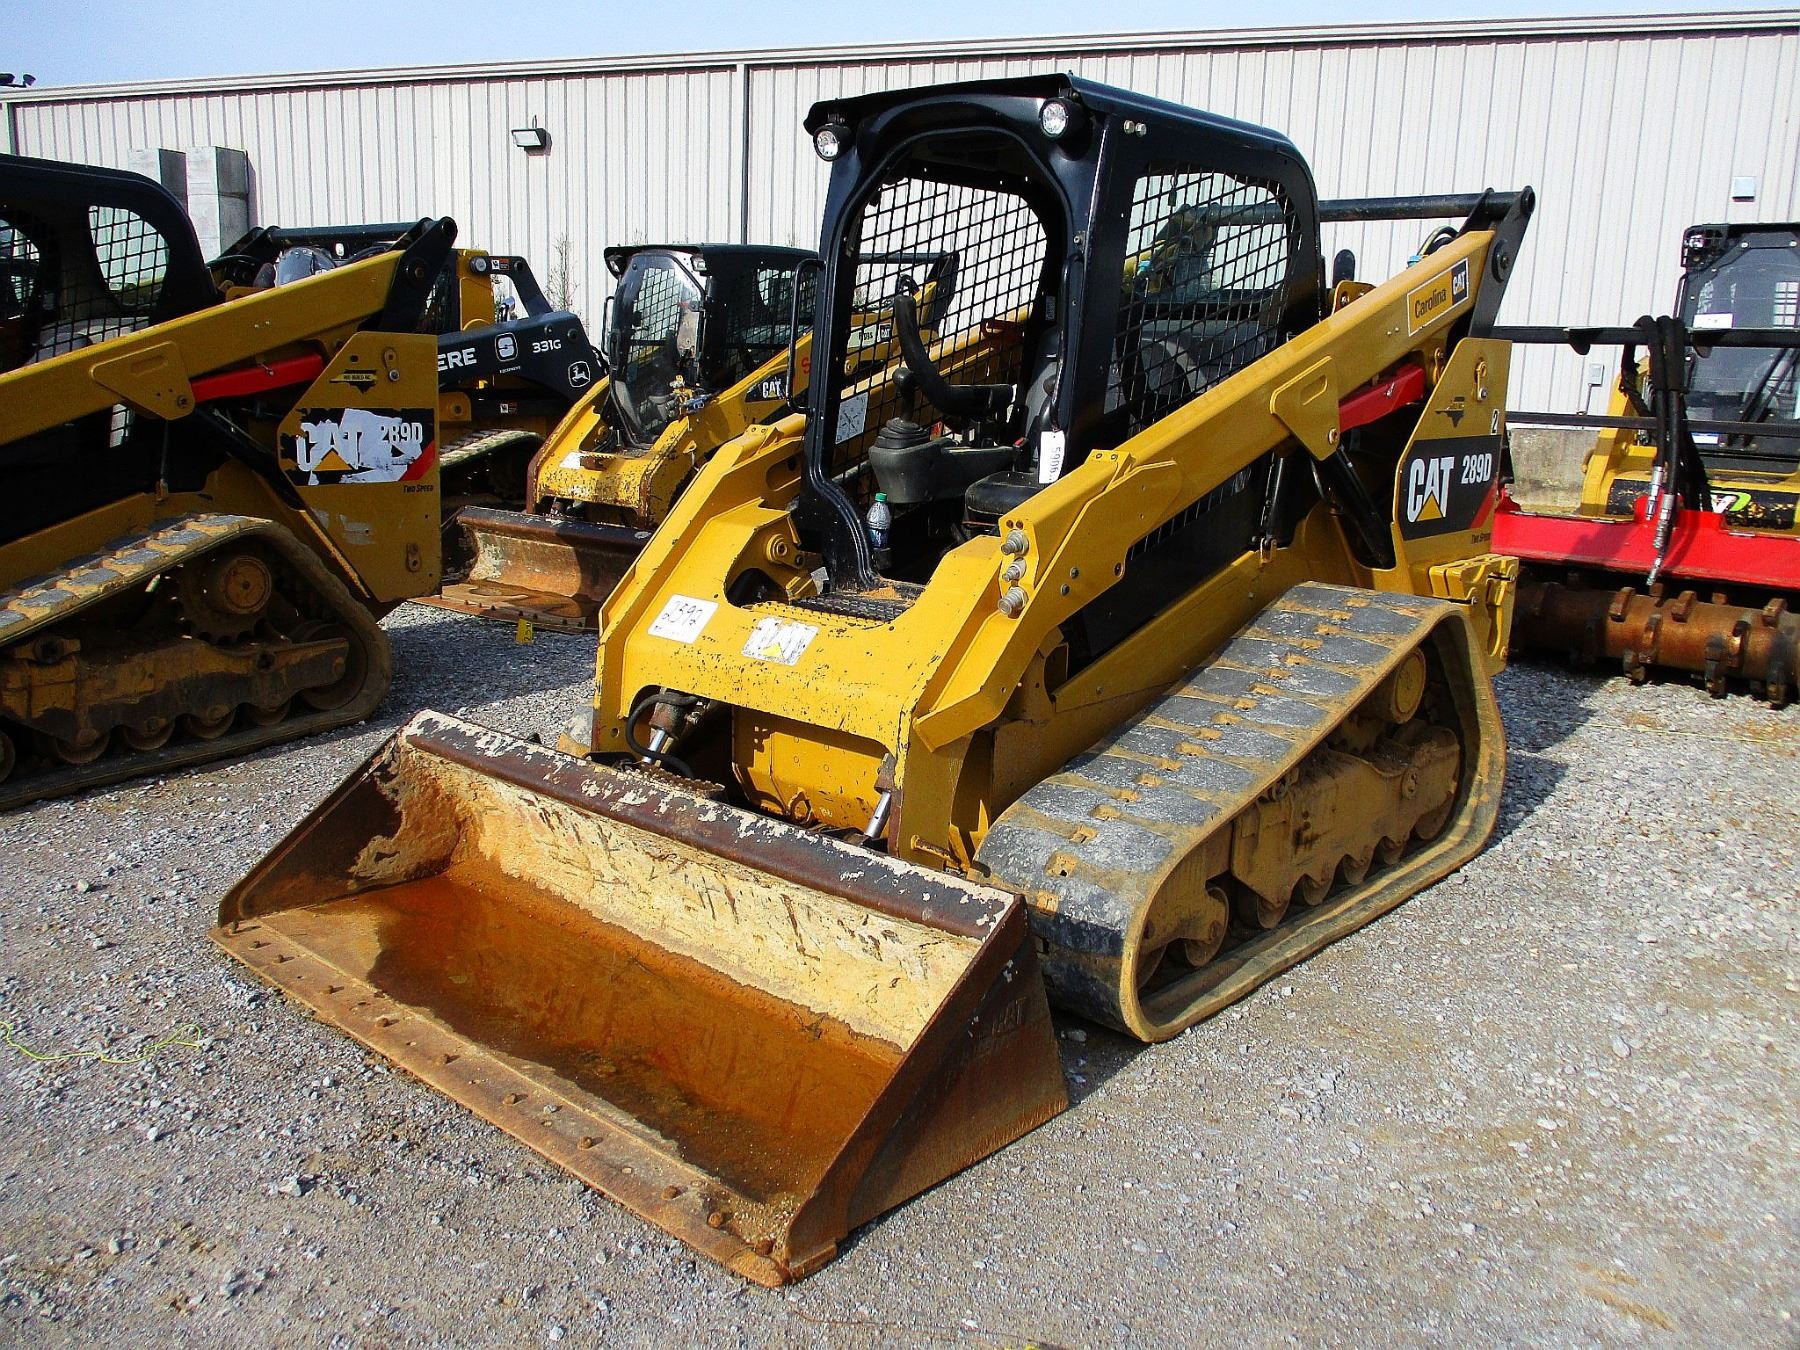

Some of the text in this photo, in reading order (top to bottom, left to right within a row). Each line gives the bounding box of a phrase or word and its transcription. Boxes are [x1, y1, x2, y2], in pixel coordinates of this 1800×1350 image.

[1414, 270, 1466, 318] Carolina CAT
[532, 339, 562, 353] 331G
[438, 347, 477, 371] ERE
[763, 379, 782, 399] CAT
[378, 421, 424, 445] 289D
[1491, 410, 1499, 434] 2
[1406, 453, 1493, 523] CAT 289D
